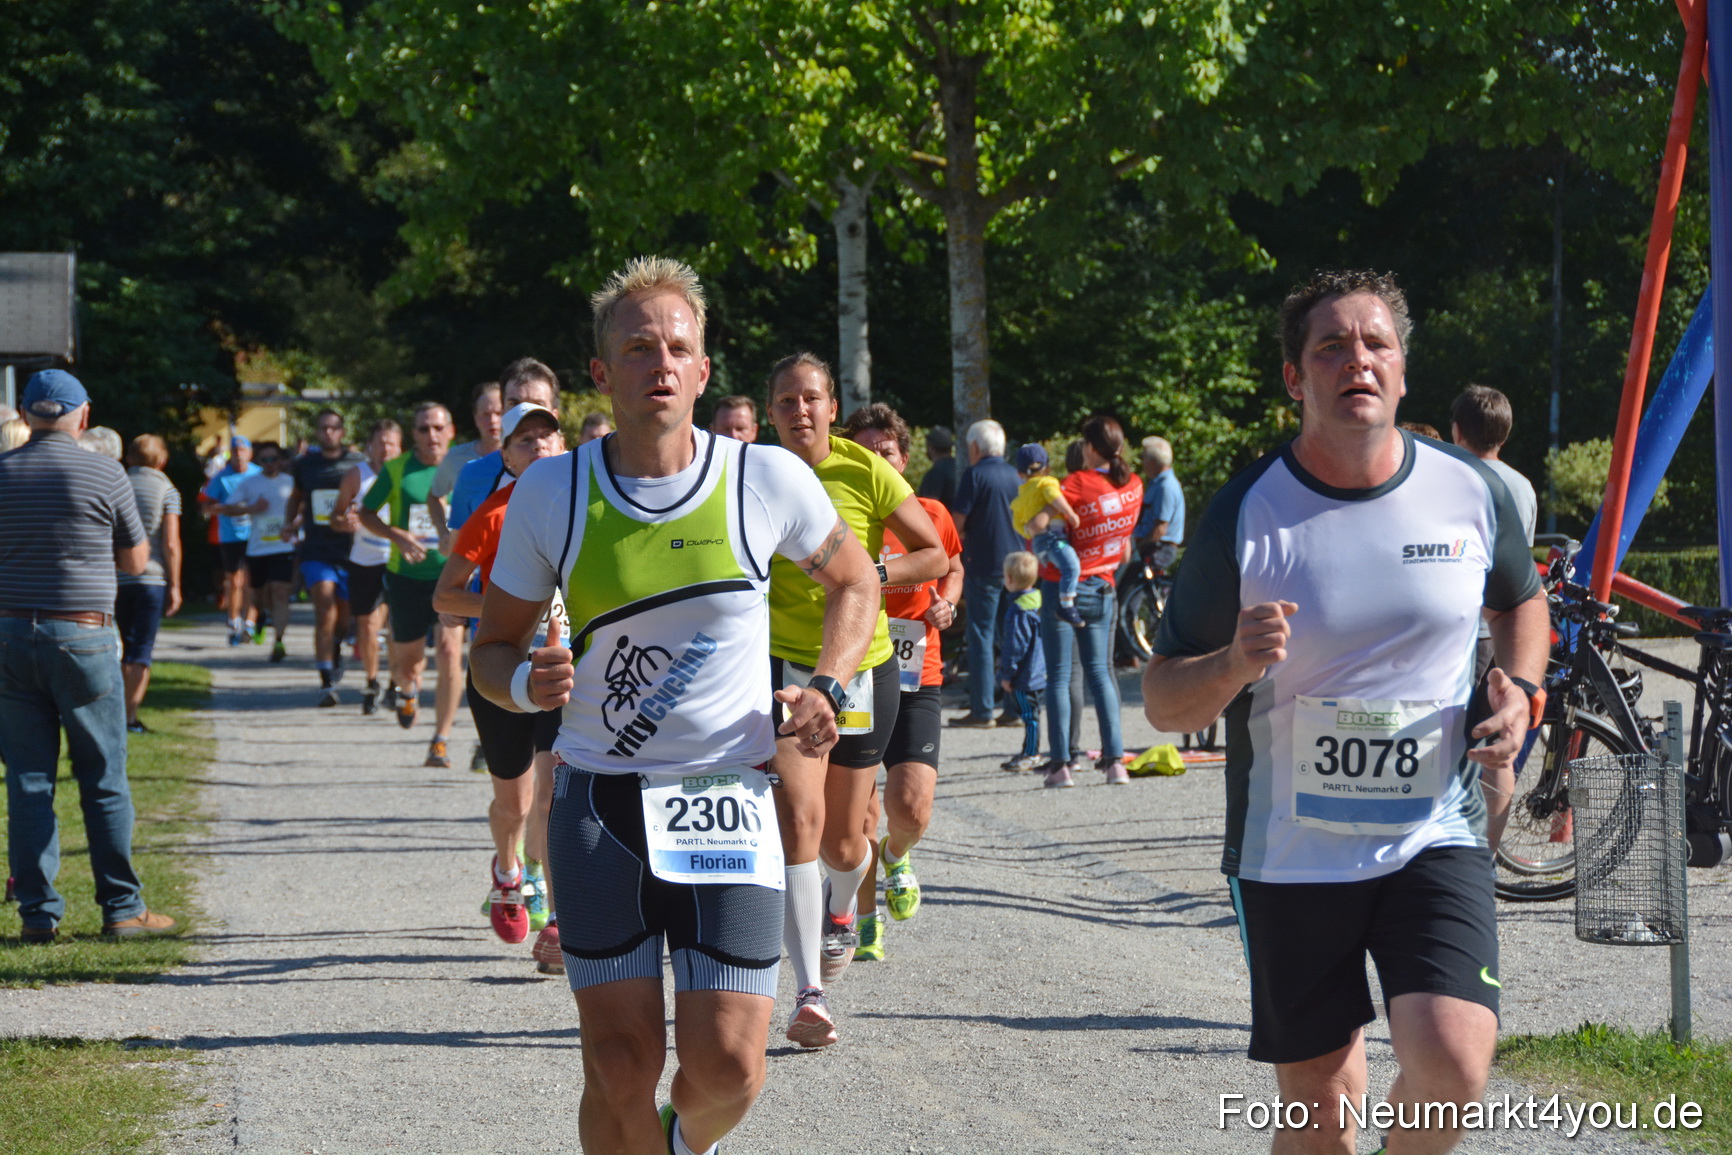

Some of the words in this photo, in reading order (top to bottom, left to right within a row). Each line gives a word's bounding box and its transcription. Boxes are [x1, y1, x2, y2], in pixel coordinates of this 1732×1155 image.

[1076, 515, 1133, 539] aumbox
[1402, 544, 1450, 558] swn
[881, 584, 924, 594] eumarkt
[889, 624, 906, 633] CK
[892, 639, 915, 660] 48
[835, 716, 846, 725] ea
[1336, 711, 1400, 726] BOCK
[1315, 735, 1419, 778] 3078
[1300, 763, 1307, 772] C
[682, 774, 741, 788] BOCK
[1322, 782, 1353, 792] PARTL
[1355, 784, 1399, 793] Neumarkt
[665, 796, 762, 833] 2306
[676, 838, 705, 846] PARTL
[707, 838, 747, 846] Neumarkt
[690, 854, 747, 870] Florian
